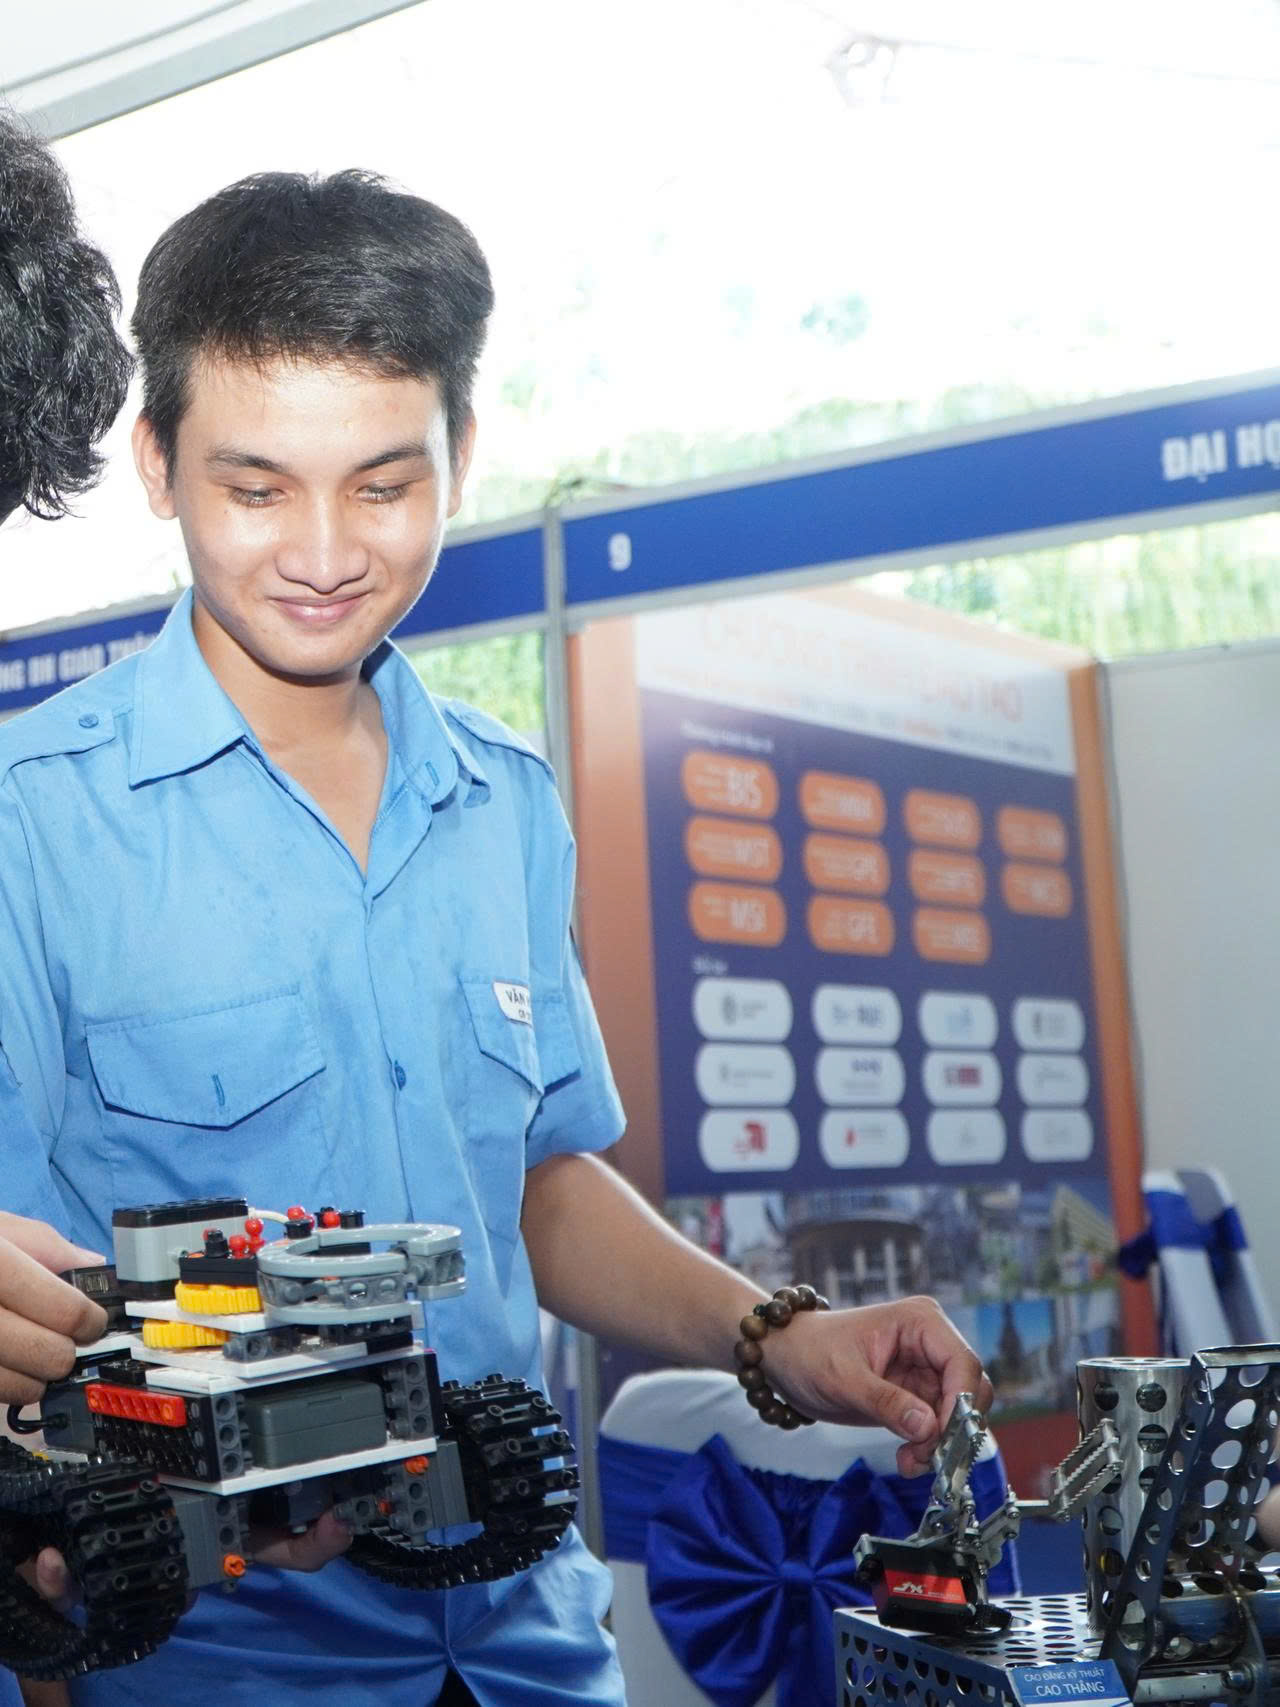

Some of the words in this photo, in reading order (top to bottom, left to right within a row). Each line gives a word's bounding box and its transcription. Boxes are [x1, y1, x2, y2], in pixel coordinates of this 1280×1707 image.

[1162, 429, 1227, 483] ĐẠI
[609, 533, 632, 571] 9
[1024, 1673, 1041, 1682] CAO
[1036, 1684, 1061, 1697] CAO
